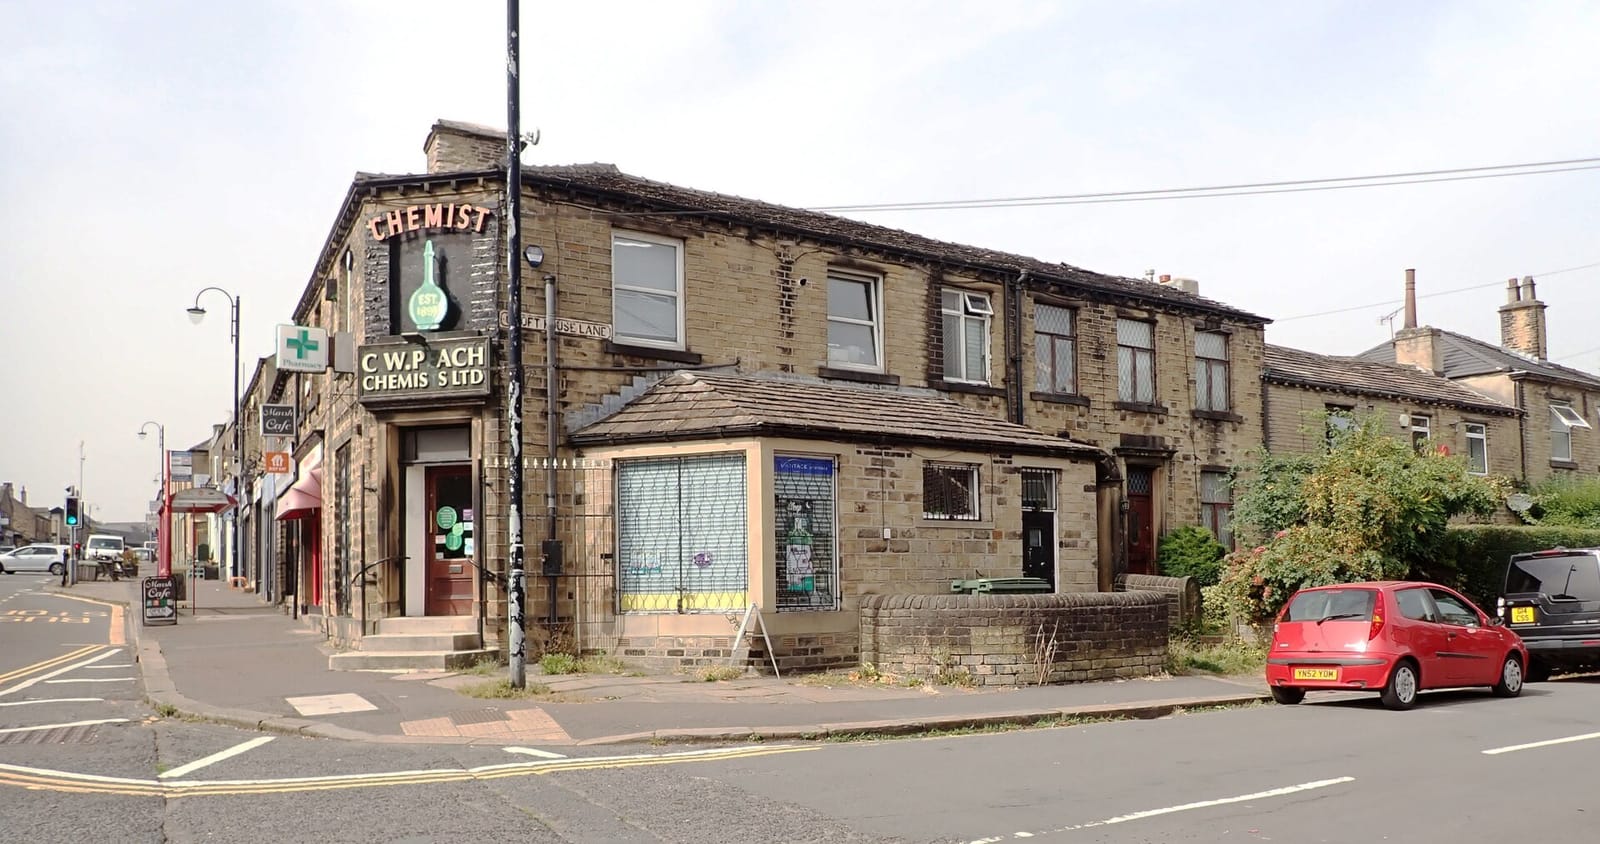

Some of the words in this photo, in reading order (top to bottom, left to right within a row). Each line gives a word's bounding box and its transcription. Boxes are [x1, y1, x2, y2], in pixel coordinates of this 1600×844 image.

[369, 202, 490, 241] CHEMIST
[578, 323, 607, 337] LANE
[283, 359, 322, 369] Pharmacy
[451, 369, 484, 386] LTD
[263, 408, 293, 417] Marsh
[145, 580, 173, 588] Marsh
[1297, 669, 1317, 678] YN52
